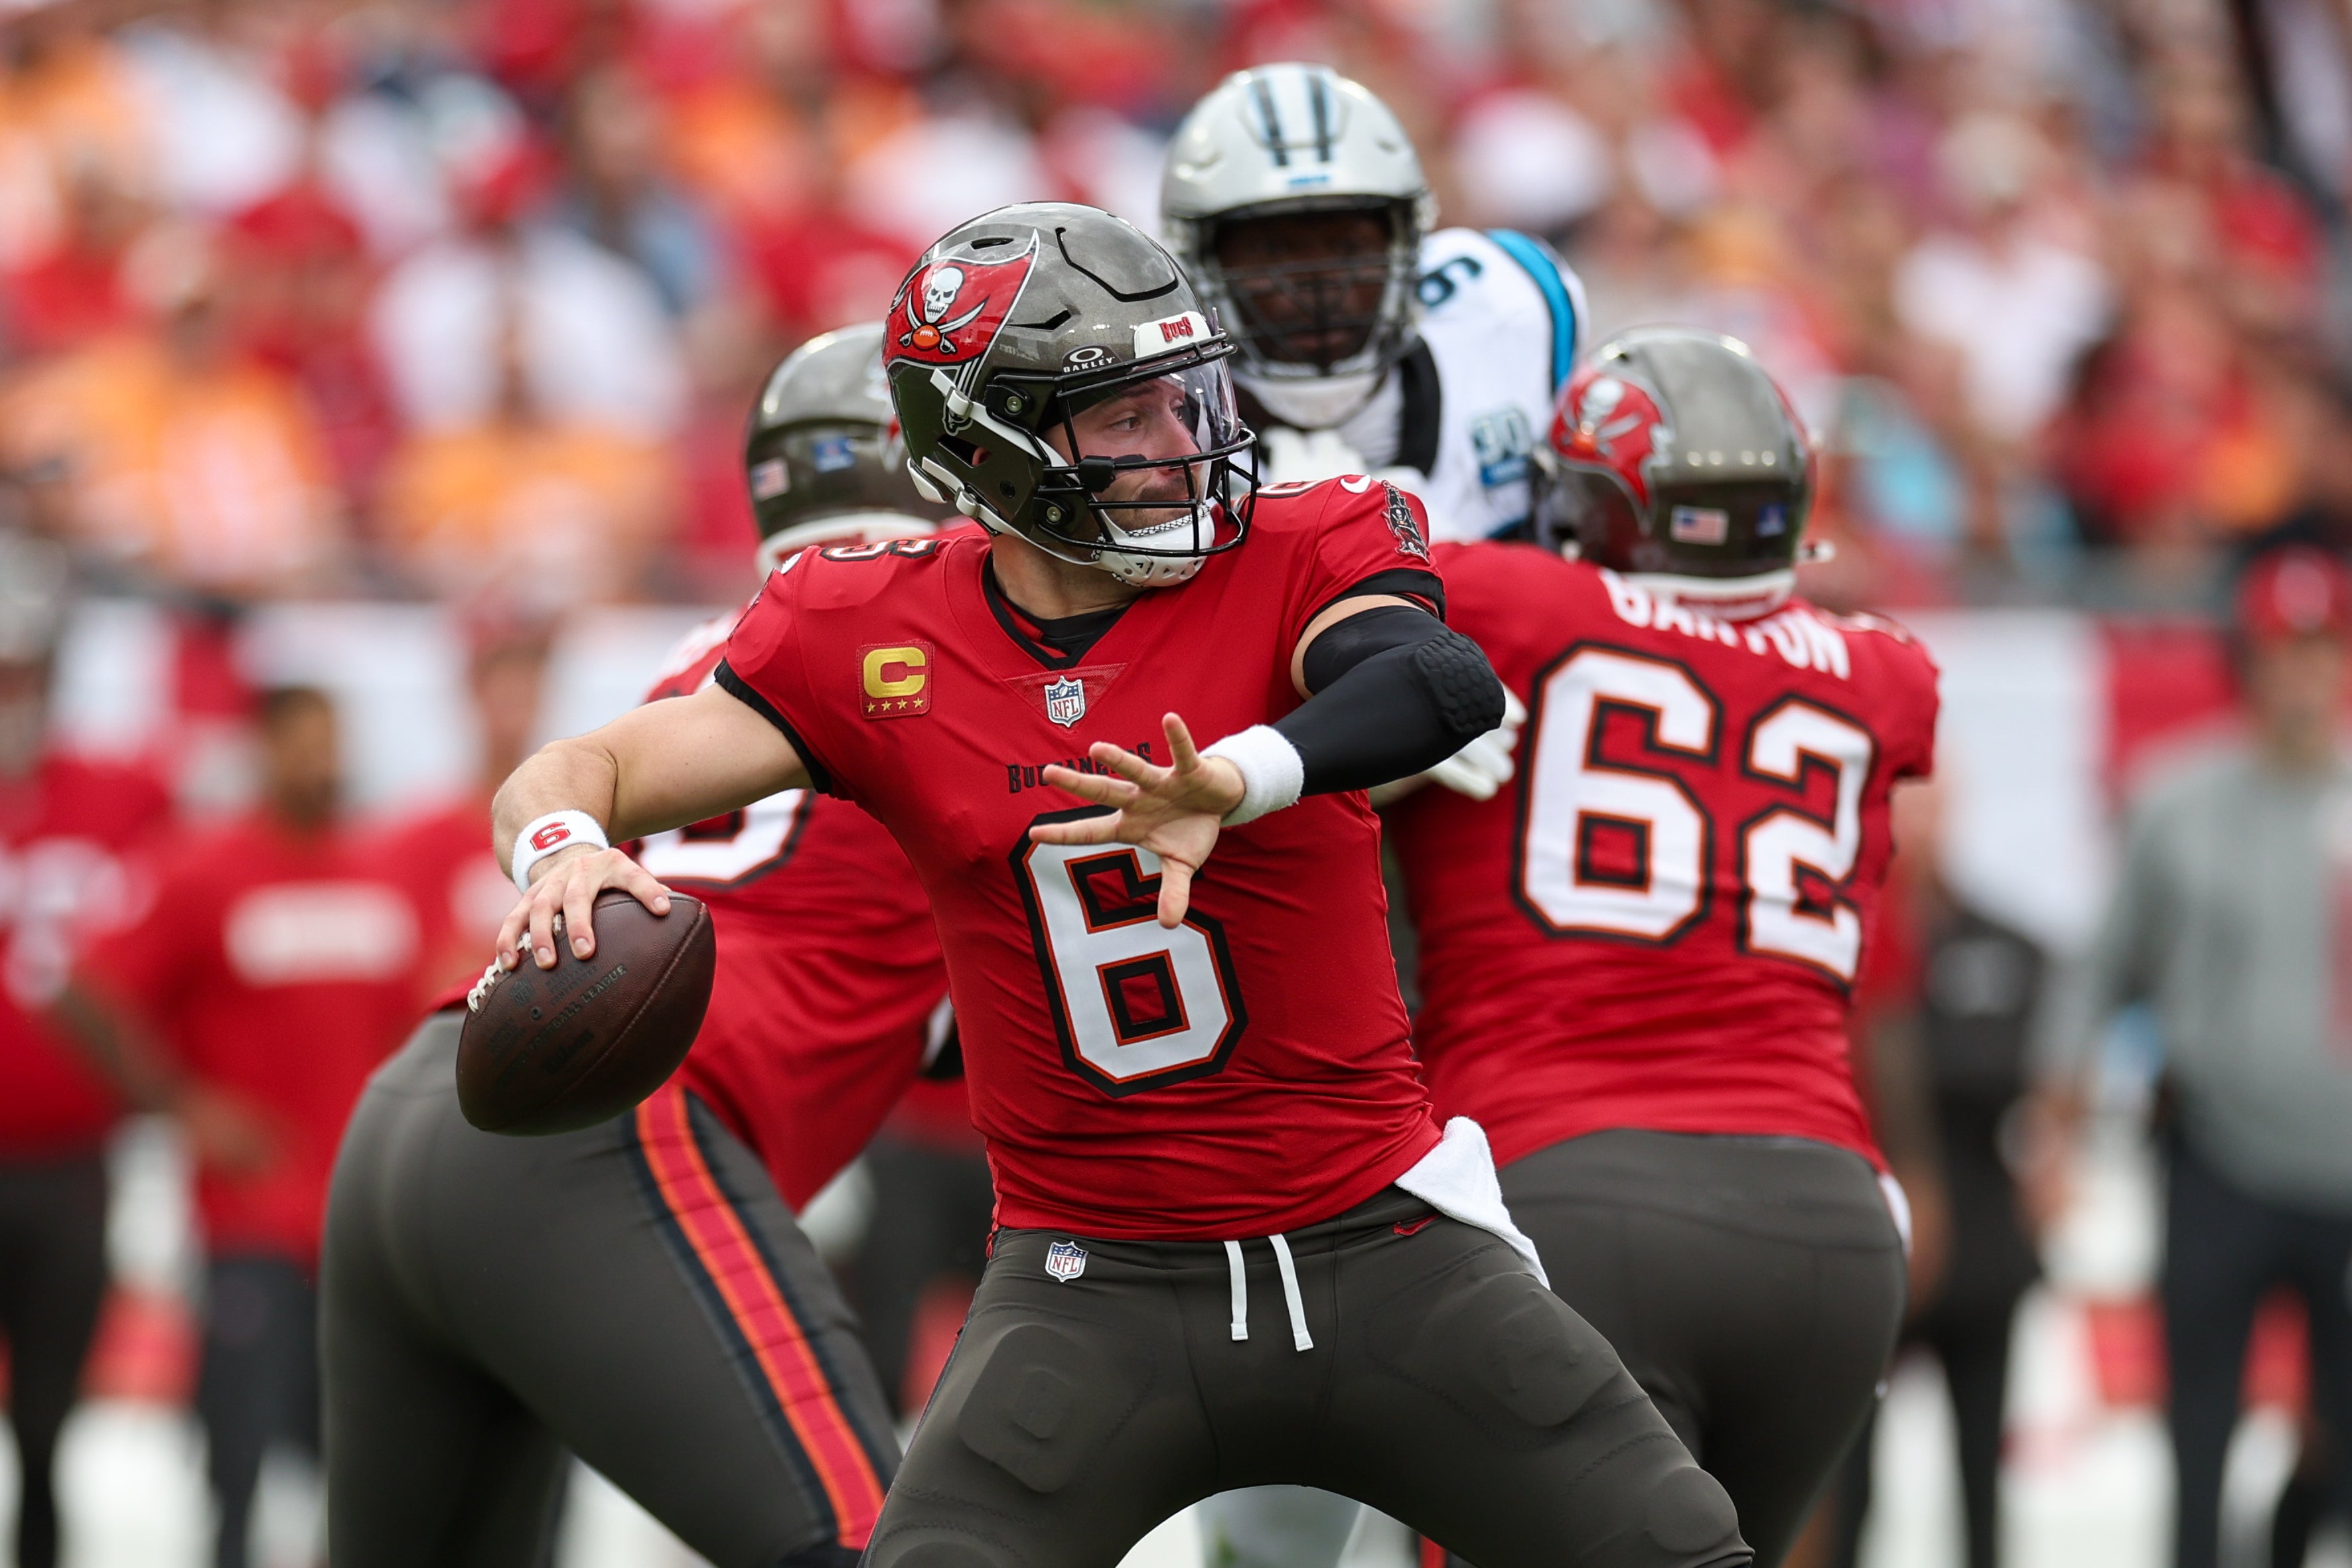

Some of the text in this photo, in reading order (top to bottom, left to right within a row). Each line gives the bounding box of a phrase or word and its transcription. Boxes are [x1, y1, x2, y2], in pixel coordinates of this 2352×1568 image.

[1159, 317, 1194, 342] BUCS
[1063, 357, 1114, 373] OAKLEY
[863, 646, 926, 699] C
[1053, 699, 1078, 718] NFL
[1006, 742, 1151, 794] BUCANES
[530, 821, 571, 851] 6
[1510, 640, 1876, 995] 62
[1007, 804, 1248, 1099] 6
[529, 1002, 581, 1052] FOOTBALL
[580, 963, 627, 1005] LEAGUE
[1052, 1255, 1077, 1273] NFL
